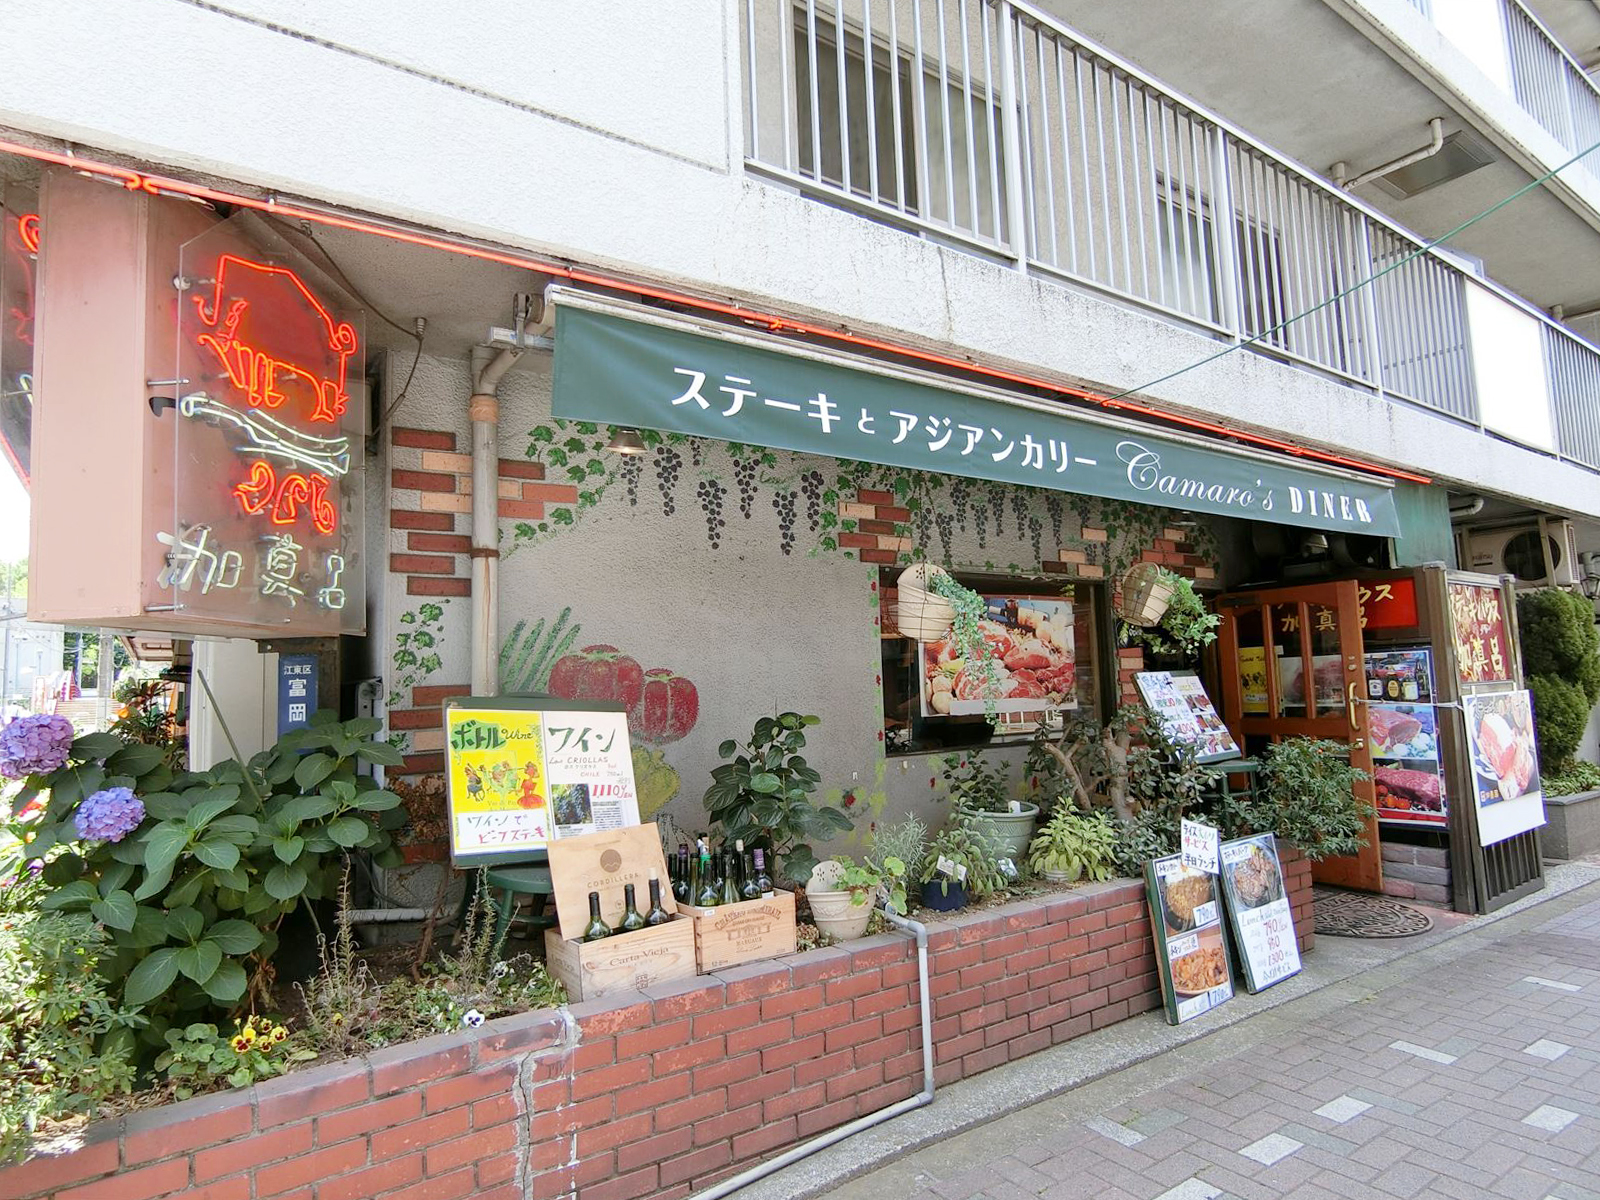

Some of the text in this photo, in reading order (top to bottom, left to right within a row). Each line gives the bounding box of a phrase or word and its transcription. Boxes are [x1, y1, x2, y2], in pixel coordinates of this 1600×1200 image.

[1115, 441, 1372, 523] Camaro's DINER
[284, 664, 312, 676] 江東区
[288, 678, 307, 723] 富岡
[451, 719, 506, 750] ボトル
[501, 728, 534, 740] Wine
[548, 727, 616, 753] ワイン
[478, 826, 545, 844] ビーフステーキ
[587, 873, 639, 888] CORDILLERA
